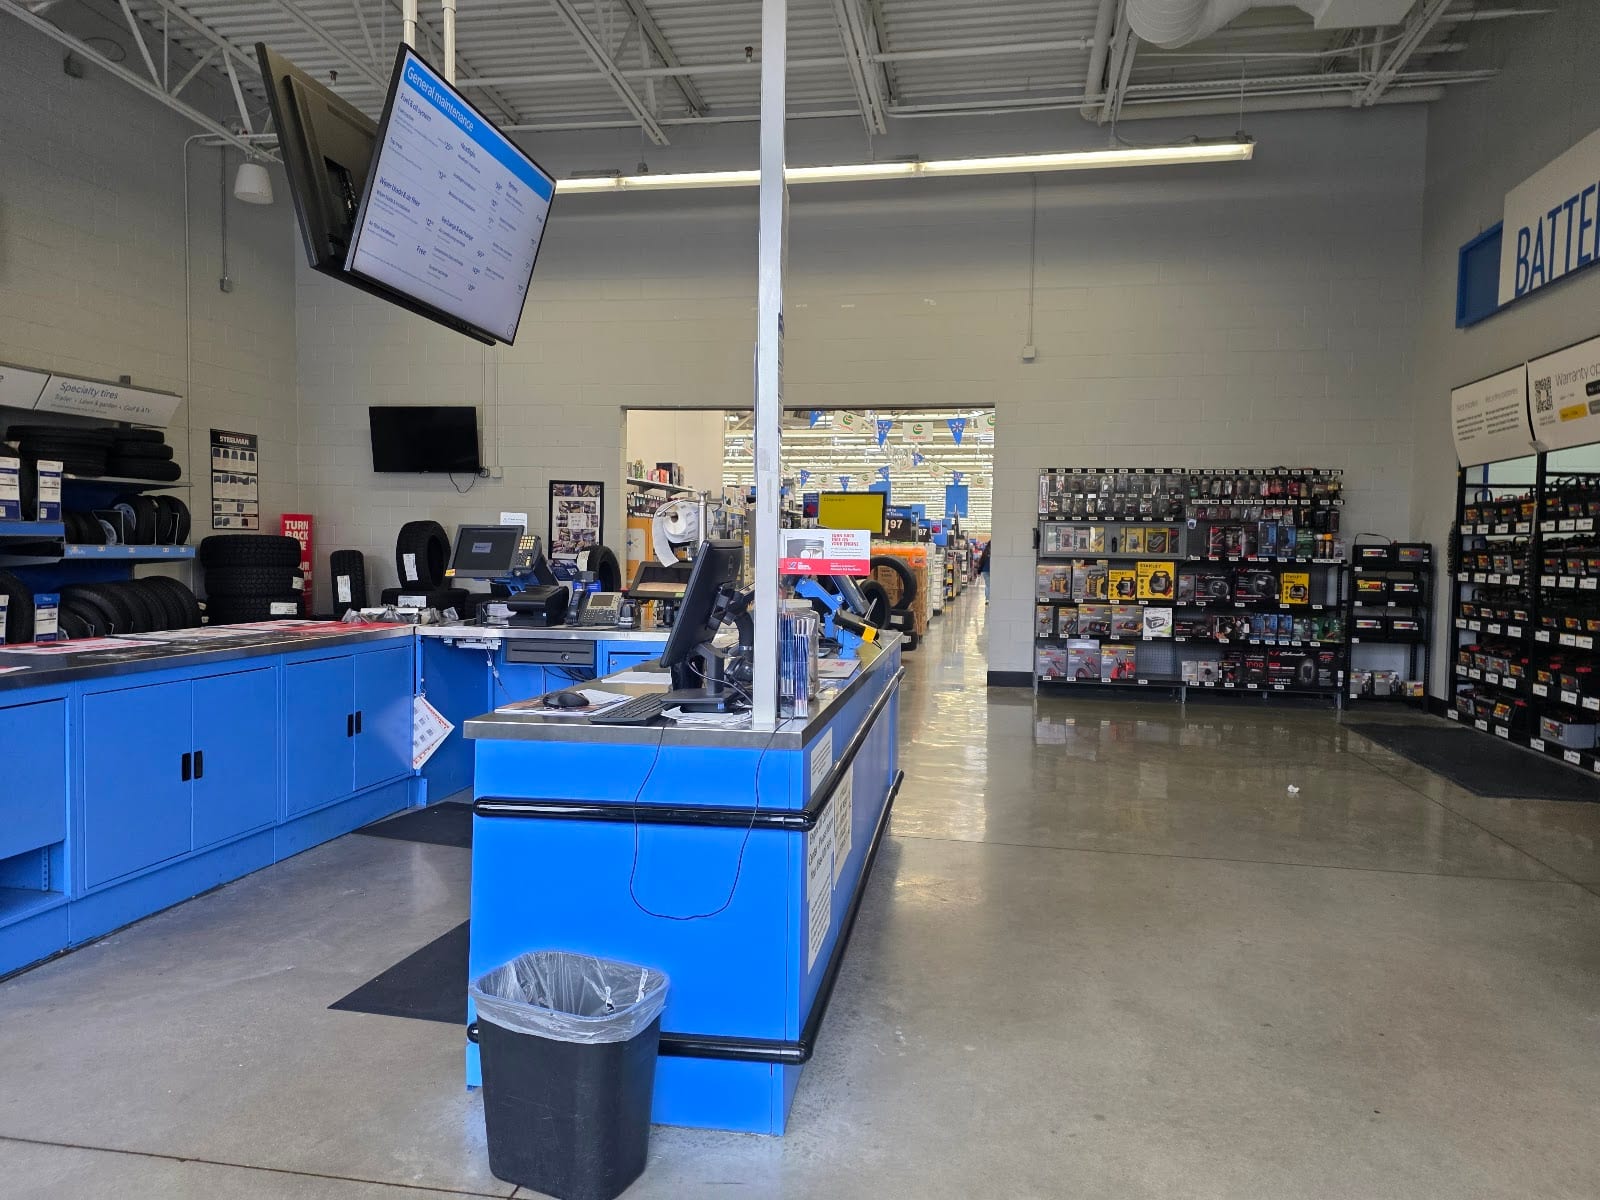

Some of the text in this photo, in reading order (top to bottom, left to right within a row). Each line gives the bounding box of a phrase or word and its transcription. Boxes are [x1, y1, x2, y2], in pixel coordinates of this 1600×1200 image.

[407, 66, 436, 98] General
[434, 92, 474, 132] maintenance
[1515, 181, 1600, 297] BATTE
[1554, 365, 1588, 387] Warranty
[60, 382, 118, 399] Specialty tires
[219, 436, 249, 445] STEELMAN
[285, 521, 309, 530] TURN
